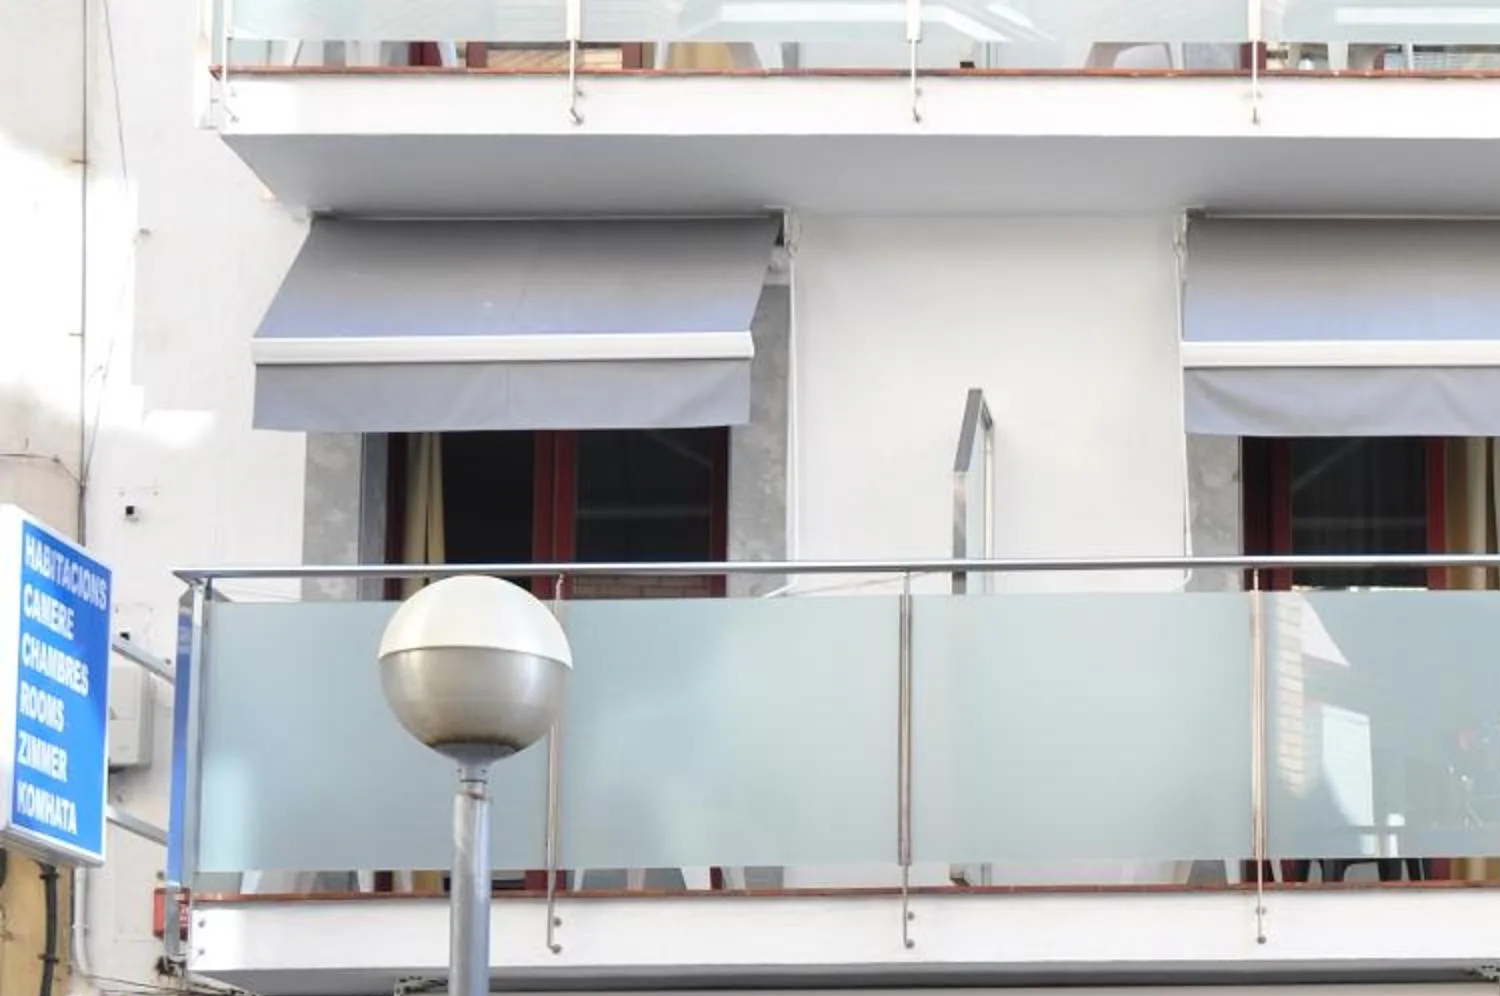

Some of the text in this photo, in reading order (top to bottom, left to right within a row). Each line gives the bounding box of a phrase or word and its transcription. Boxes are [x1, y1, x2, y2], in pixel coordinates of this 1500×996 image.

[24, 534, 107, 611] HABITACIONS
[21, 632, 89, 697] CHAMBRES
[20, 680, 65, 733] ROOMS
[18, 730, 68, 783] ZIMMER
